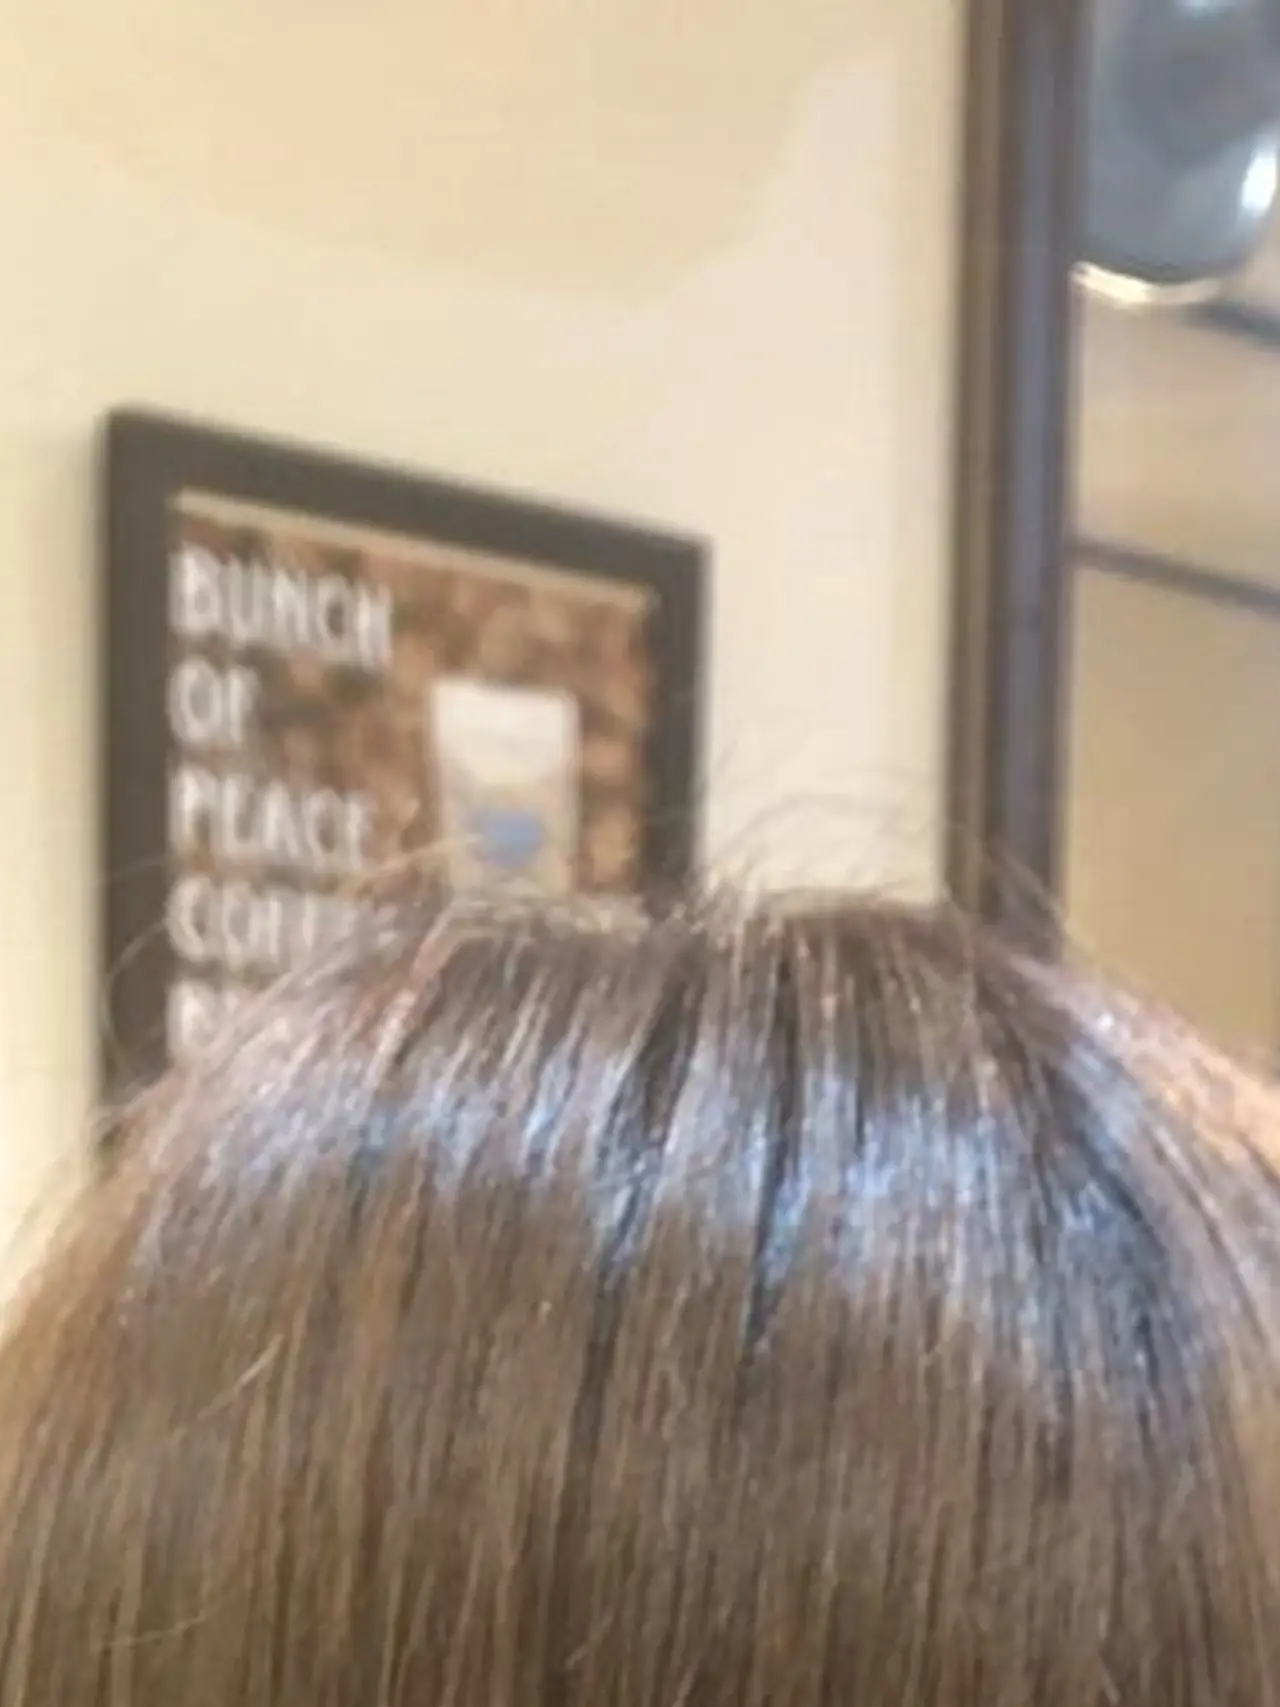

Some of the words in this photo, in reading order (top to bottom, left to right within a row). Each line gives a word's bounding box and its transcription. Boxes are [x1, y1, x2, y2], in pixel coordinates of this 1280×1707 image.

[171, 546, 392, 668] BUNCH
[169, 659, 256, 747] OF
[169, 766, 376, 876] PEACE
